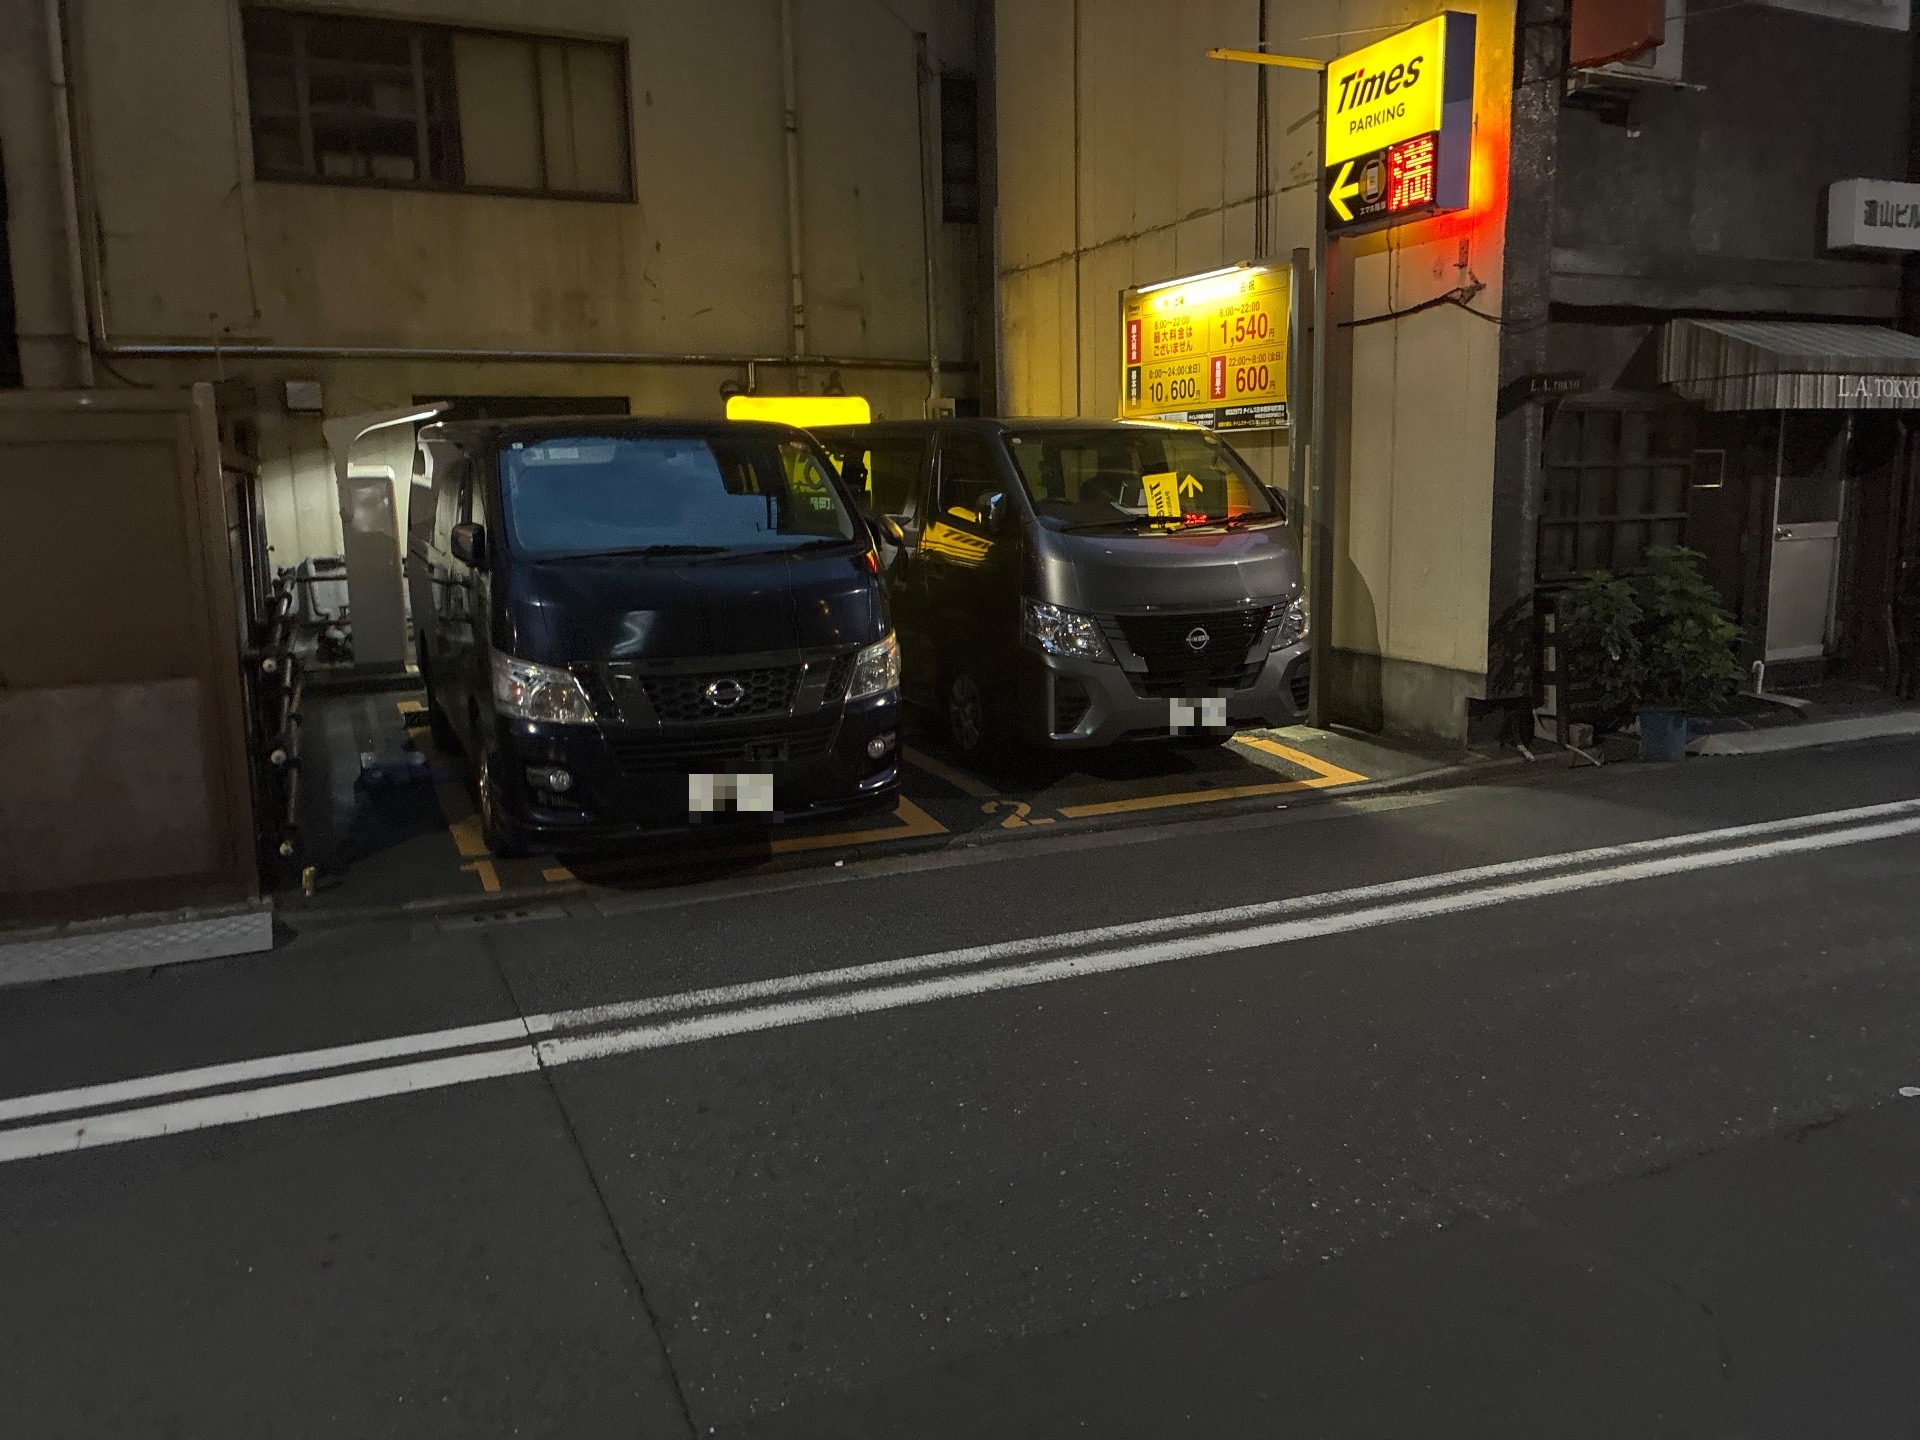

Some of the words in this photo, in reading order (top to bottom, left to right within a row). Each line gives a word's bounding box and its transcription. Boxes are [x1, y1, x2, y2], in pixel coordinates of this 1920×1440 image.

[1336, 56, 1423, 114] Times
[1350, 102, 1405, 135] PARKING
[1154, 326, 1193, 343] 最大料金は
[1154, 340, 1193, 356] ございません
[981, 800, 1055, 829] 2
